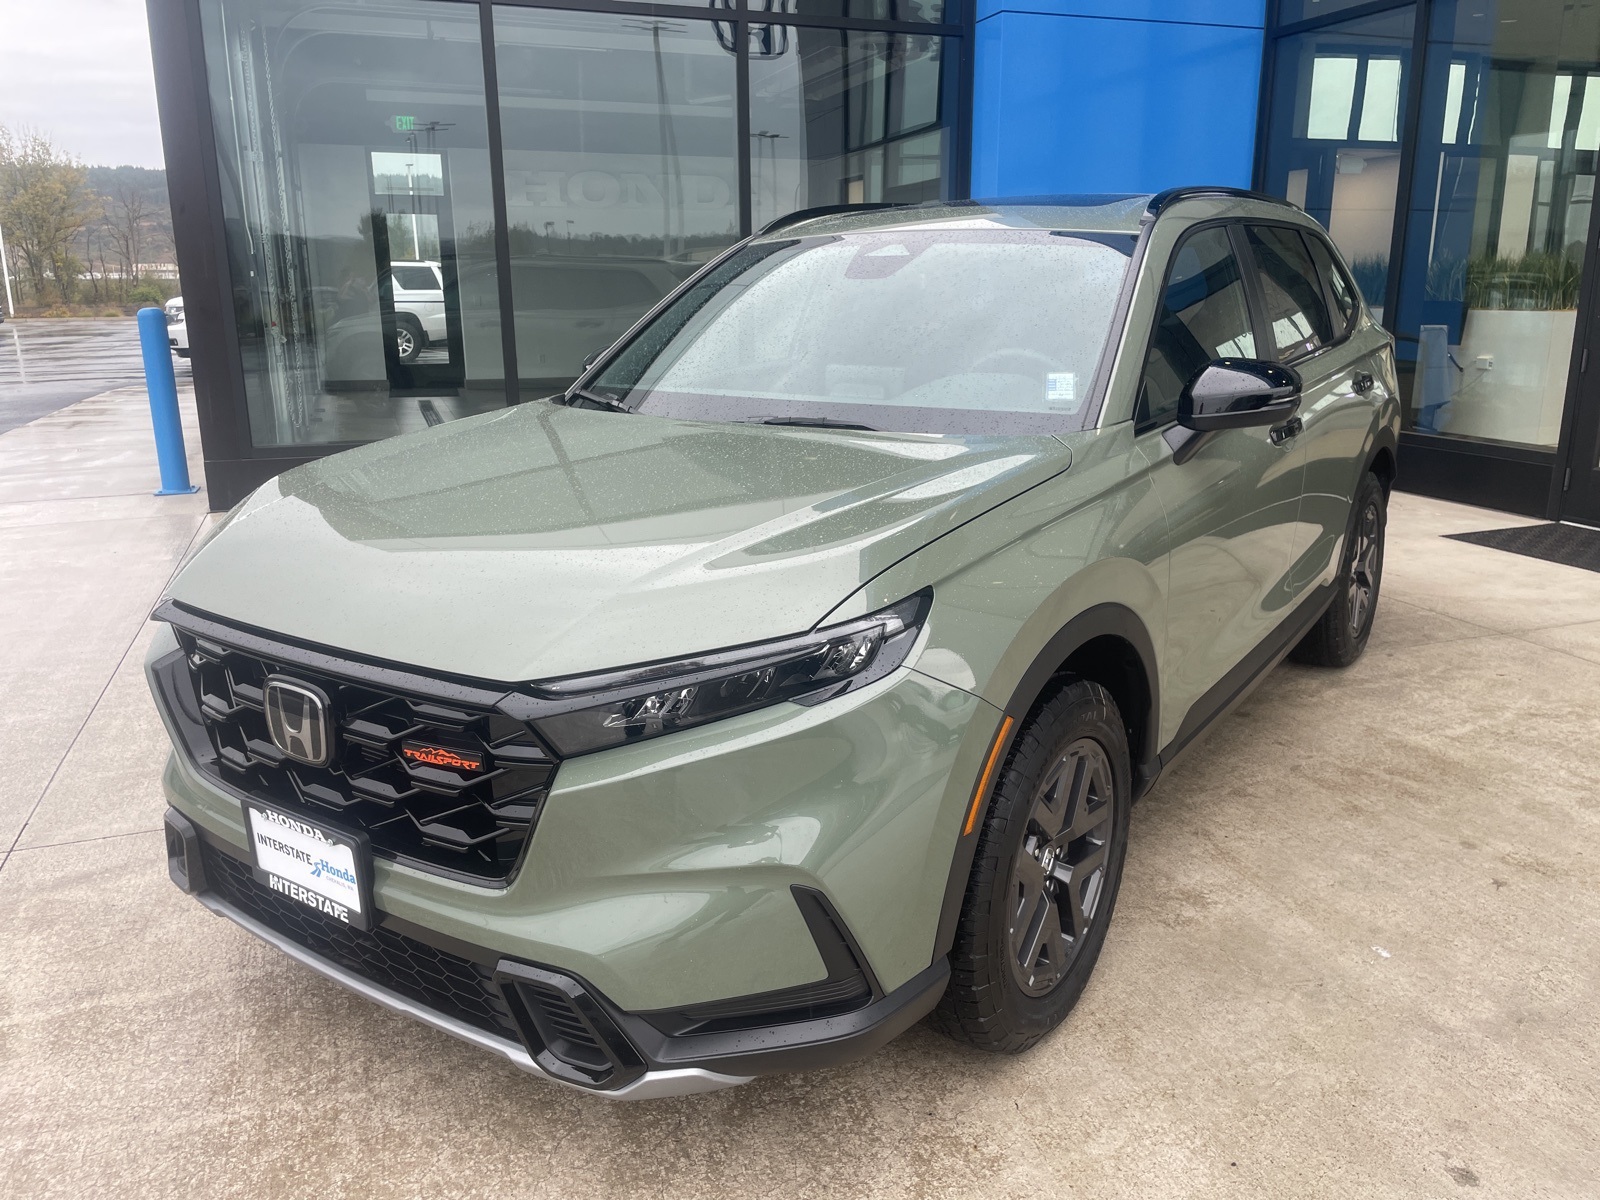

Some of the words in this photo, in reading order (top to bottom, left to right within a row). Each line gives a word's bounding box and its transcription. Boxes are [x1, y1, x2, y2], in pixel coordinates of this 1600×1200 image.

[396, 116, 415, 131] EXIT
[404, 749, 480, 770] TRAILSPORT
[265, 809, 328, 843] HONDA
[257, 832, 313, 866] INTERSTATE
[320, 859, 356, 884] Honda
[269, 874, 349, 923] INTERSTATE
